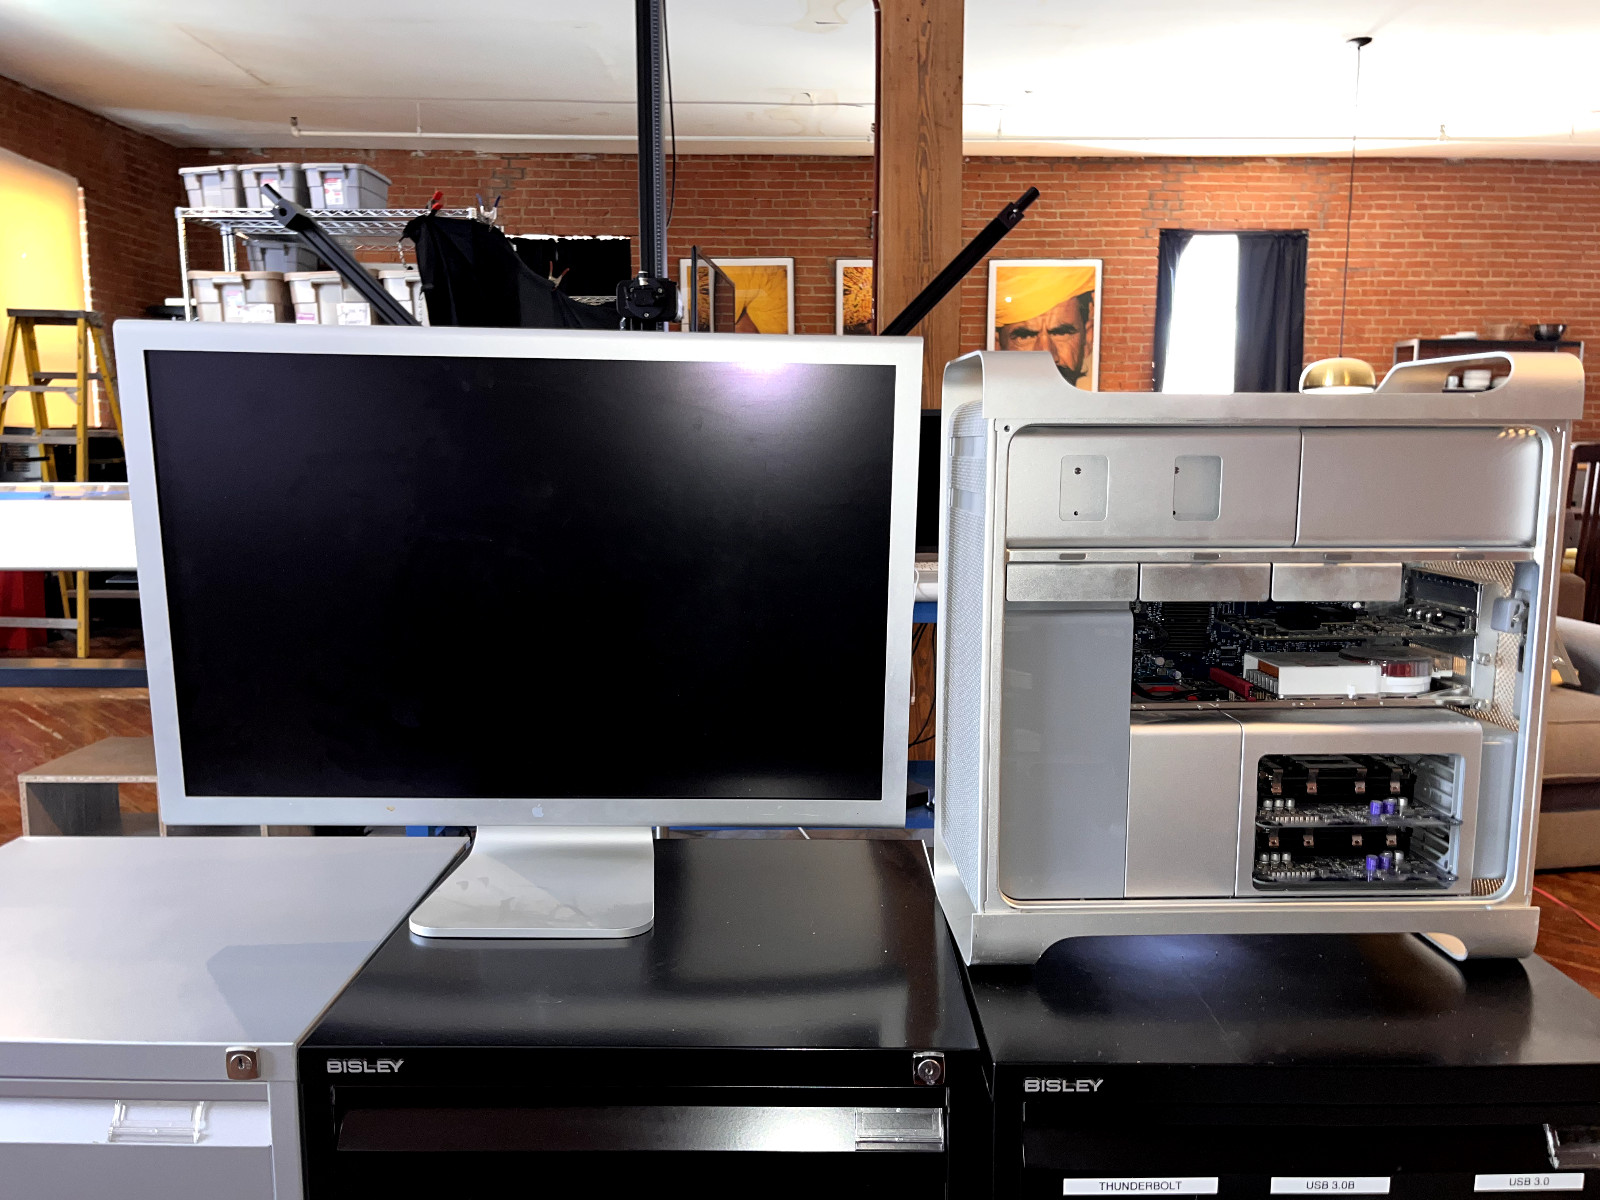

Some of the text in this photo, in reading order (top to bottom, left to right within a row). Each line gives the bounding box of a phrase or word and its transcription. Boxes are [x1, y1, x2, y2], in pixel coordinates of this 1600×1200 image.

[326, 1058, 405, 1074] BISLEY
[1023, 1078, 1104, 1093] BISLEY
[1098, 1180, 1183, 1191] THUNDERBOLT
[1306, 1180, 1355, 1190] USB 3.0B
[1509, 1176, 1550, 1186] USB 3.0
